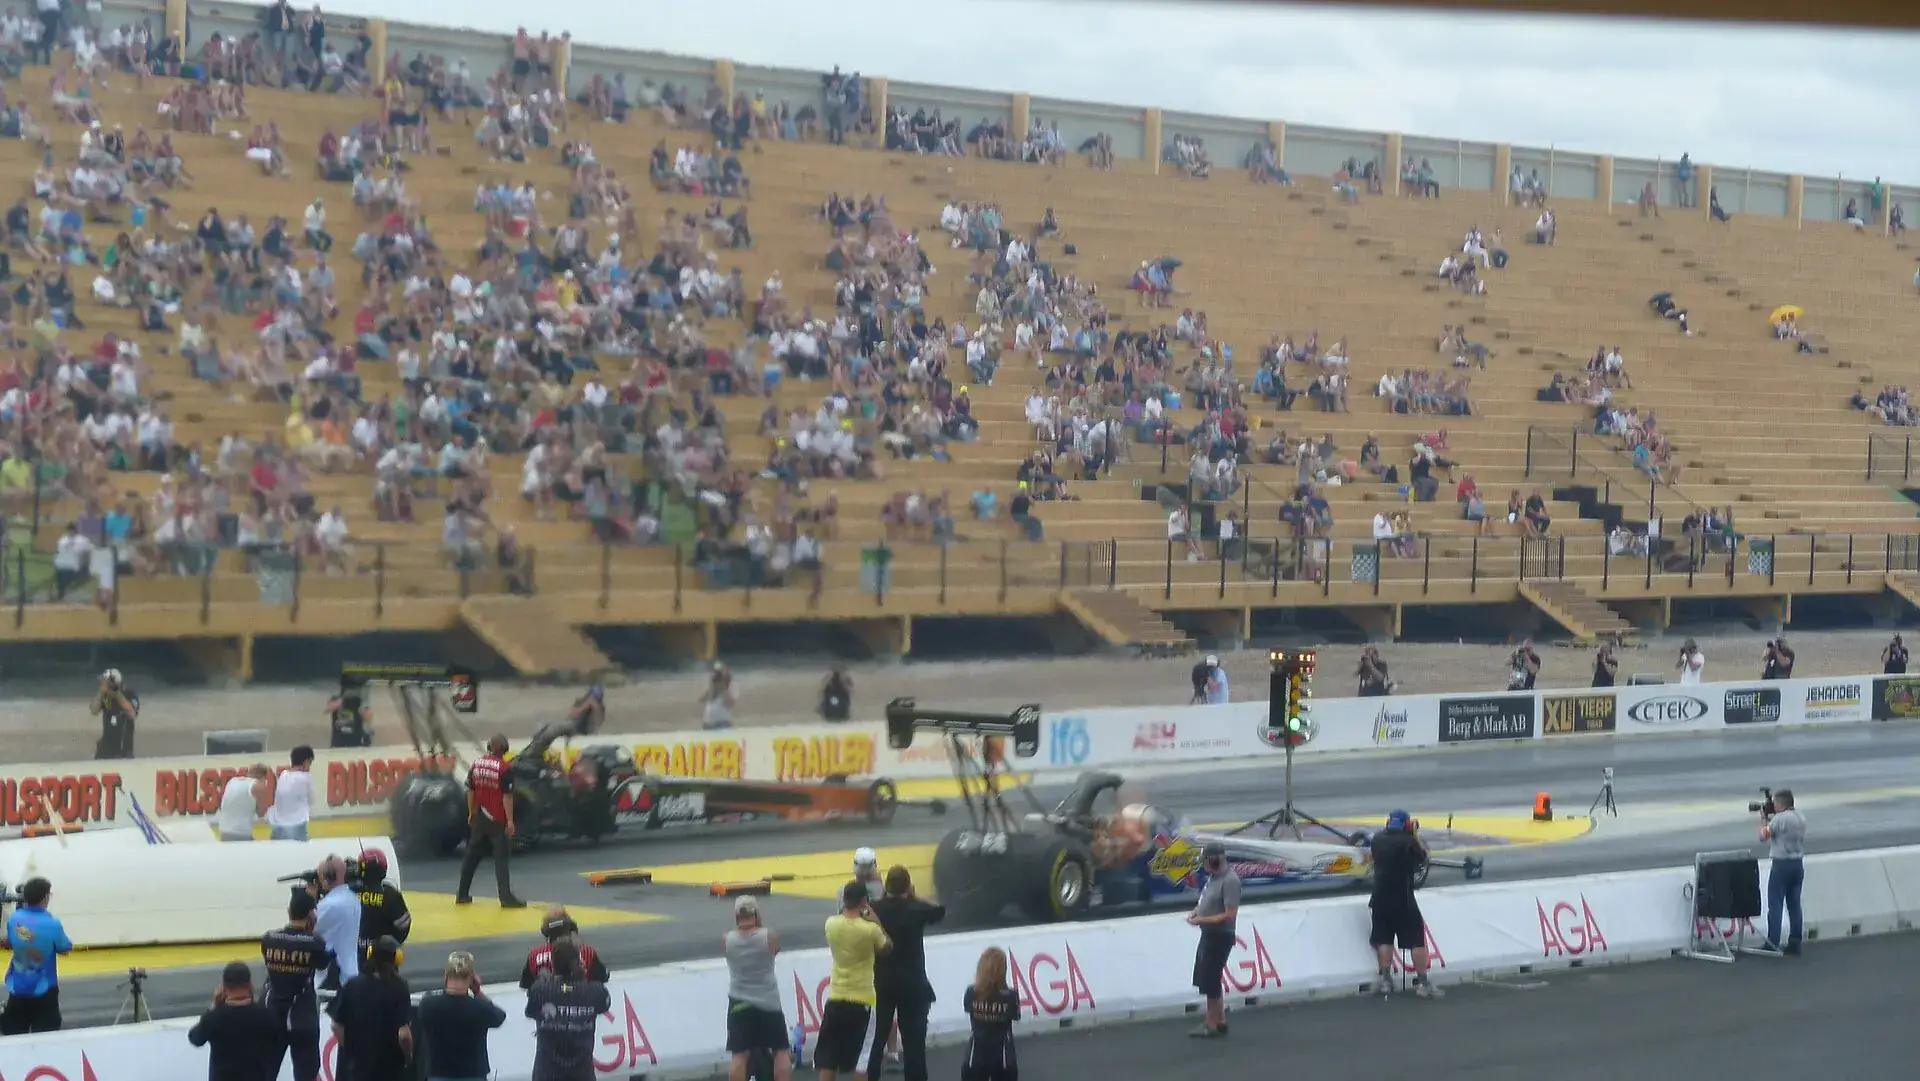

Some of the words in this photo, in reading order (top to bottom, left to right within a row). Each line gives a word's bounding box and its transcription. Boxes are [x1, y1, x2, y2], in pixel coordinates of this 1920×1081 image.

[1643, 701, 1690, 721] CTEK
[1806, 684, 1860, 701] JEHANDER
[1483, 714, 1508, 735] Mark
[1510, 713, 1526, 733] AB
[773, 733, 876, 782] TRAILER
[1536, 892, 1608, 957] AGA
[1008, 939, 1096, 1016] AGA
[1220, 923, 1282, 993] GA
[594, 988, 657, 1072] GA
